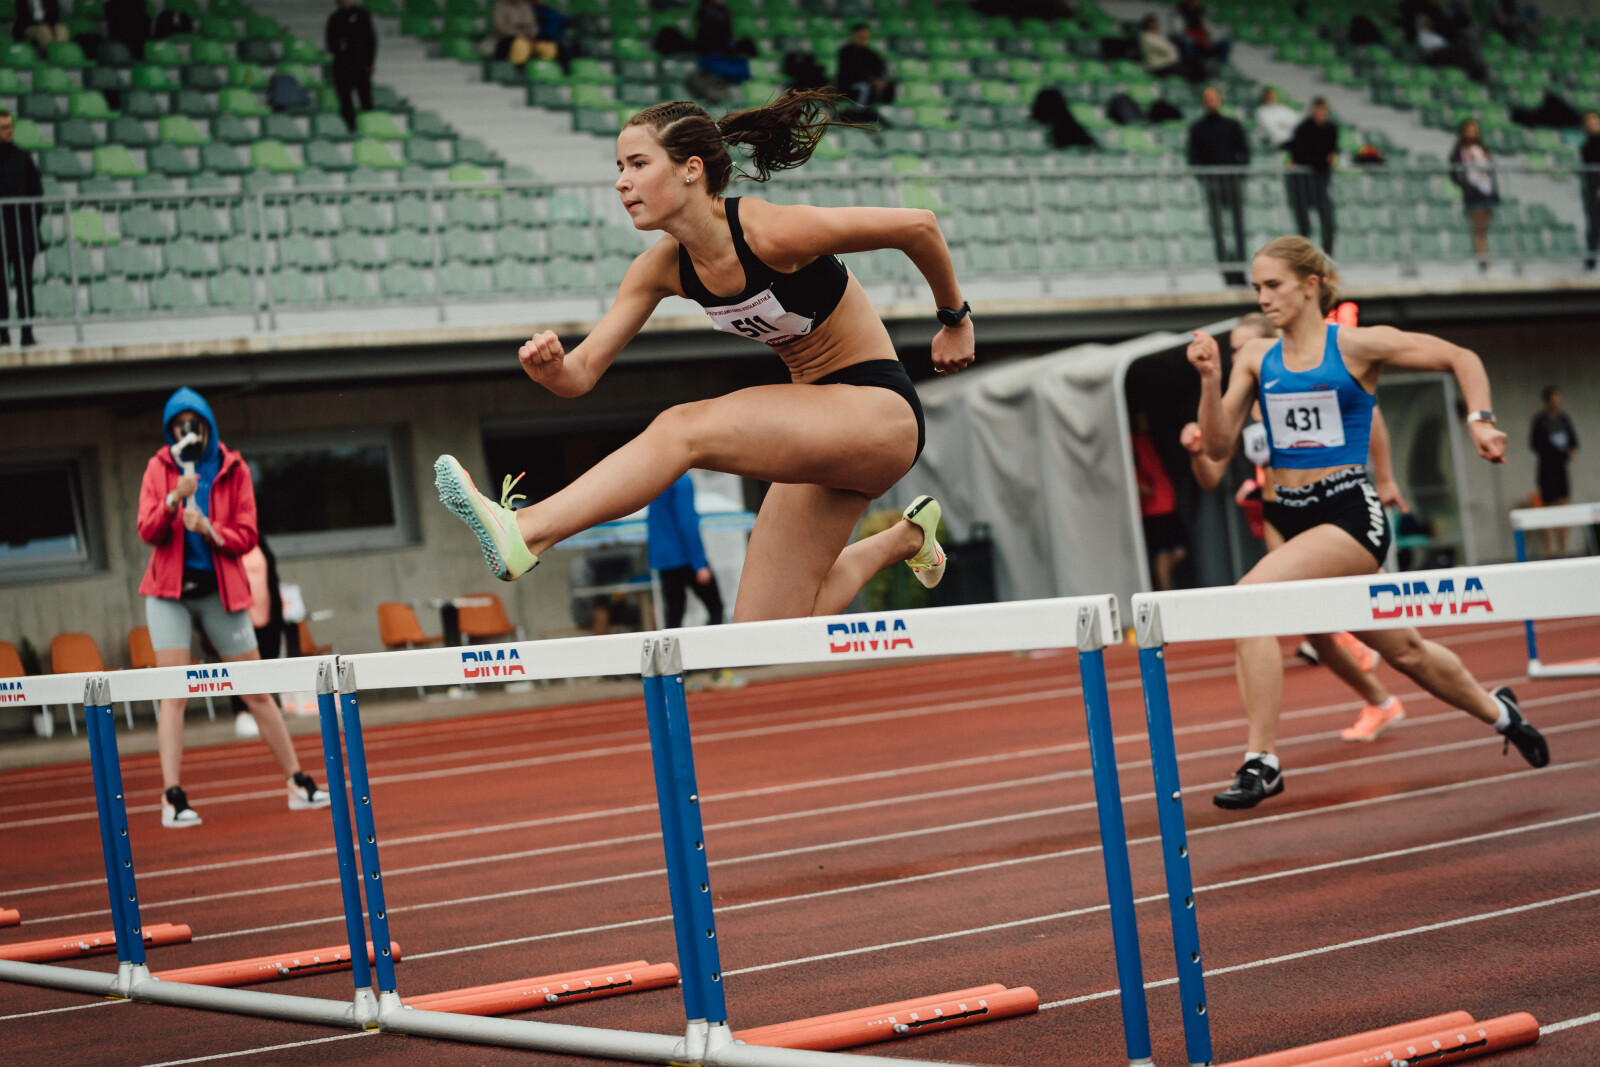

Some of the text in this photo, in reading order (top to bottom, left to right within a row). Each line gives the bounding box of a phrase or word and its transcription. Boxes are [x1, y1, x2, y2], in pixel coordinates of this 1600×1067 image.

[731, 315, 780, 338] 511
[1286, 407, 1321, 431] 431
[1361, 482, 1384, 548] NIKE
[1370, 578, 1493, 619] DIMA
[828, 619, 913, 654] DIMA
[461, 648, 525, 678] DIMA
[0, 681, 26, 702] IMA
[187, 668, 233, 693] DIMA
